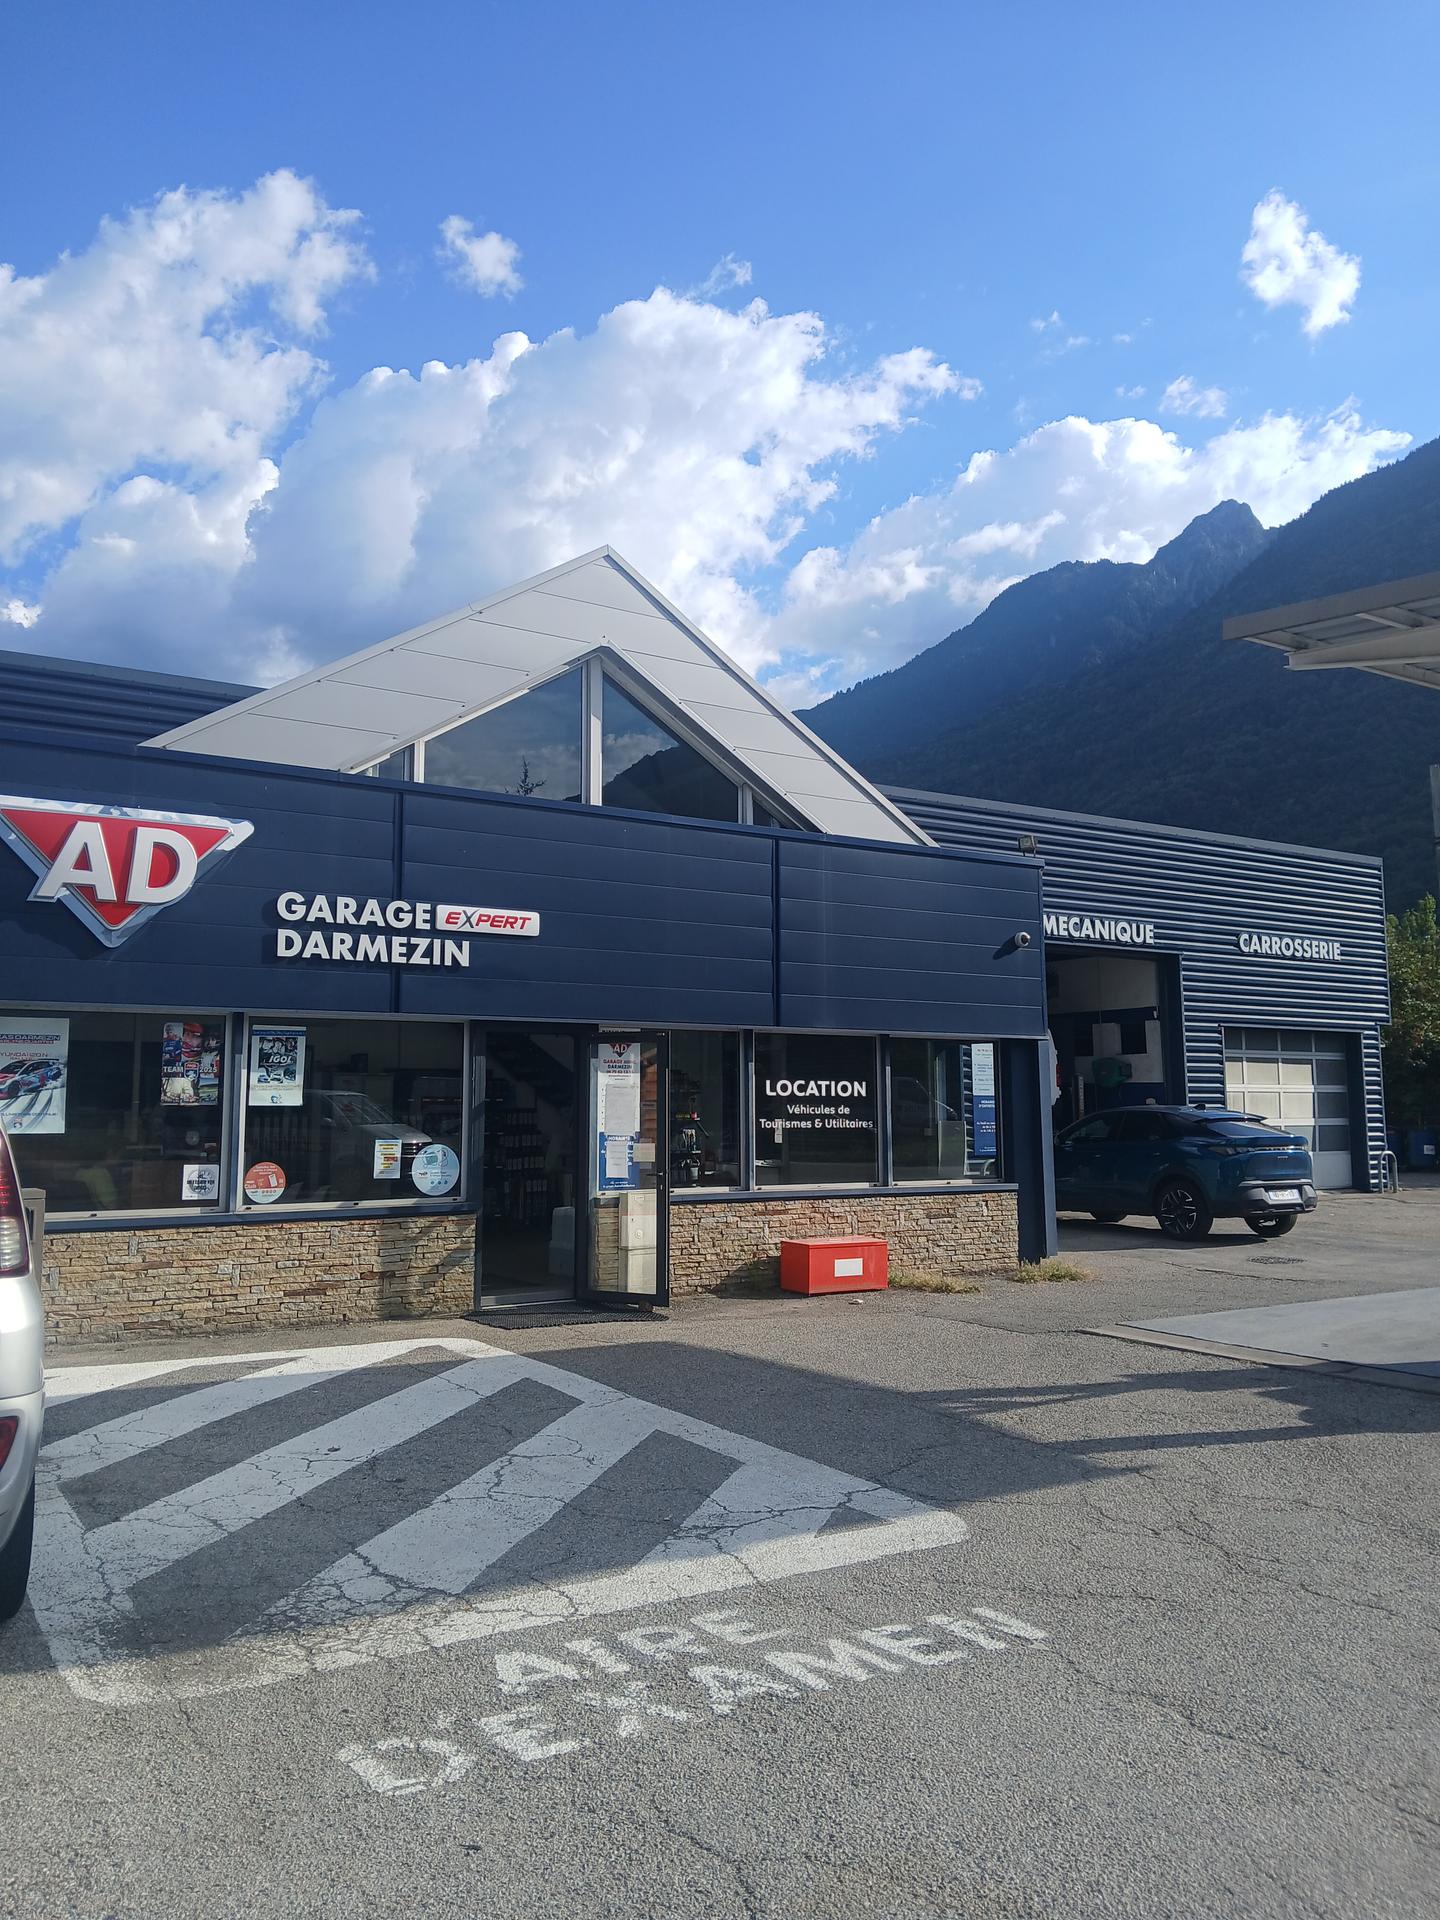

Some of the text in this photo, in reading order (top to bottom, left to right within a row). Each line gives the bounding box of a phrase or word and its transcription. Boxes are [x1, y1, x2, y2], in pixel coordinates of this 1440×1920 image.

[35, 820, 198, 904] AD
[276, 891, 431, 930] GARAGE
[444, 908, 532, 930] EXPERT
[1043, 914, 1155, 944] MECANIQUE
[276, 928, 470, 967] DARMEZIN
[1239, 933, 1341, 961] CARROSSERIE
[268, 1055, 293, 1063] IGOL
[765, 1079, 867, 1097] LOCATION
[760, 1118, 873, 1129] Tourismes & Utilitaires
[787, 1104, 850, 1115] Véhicules de
[494, 1604, 798, 1696] AIRE
